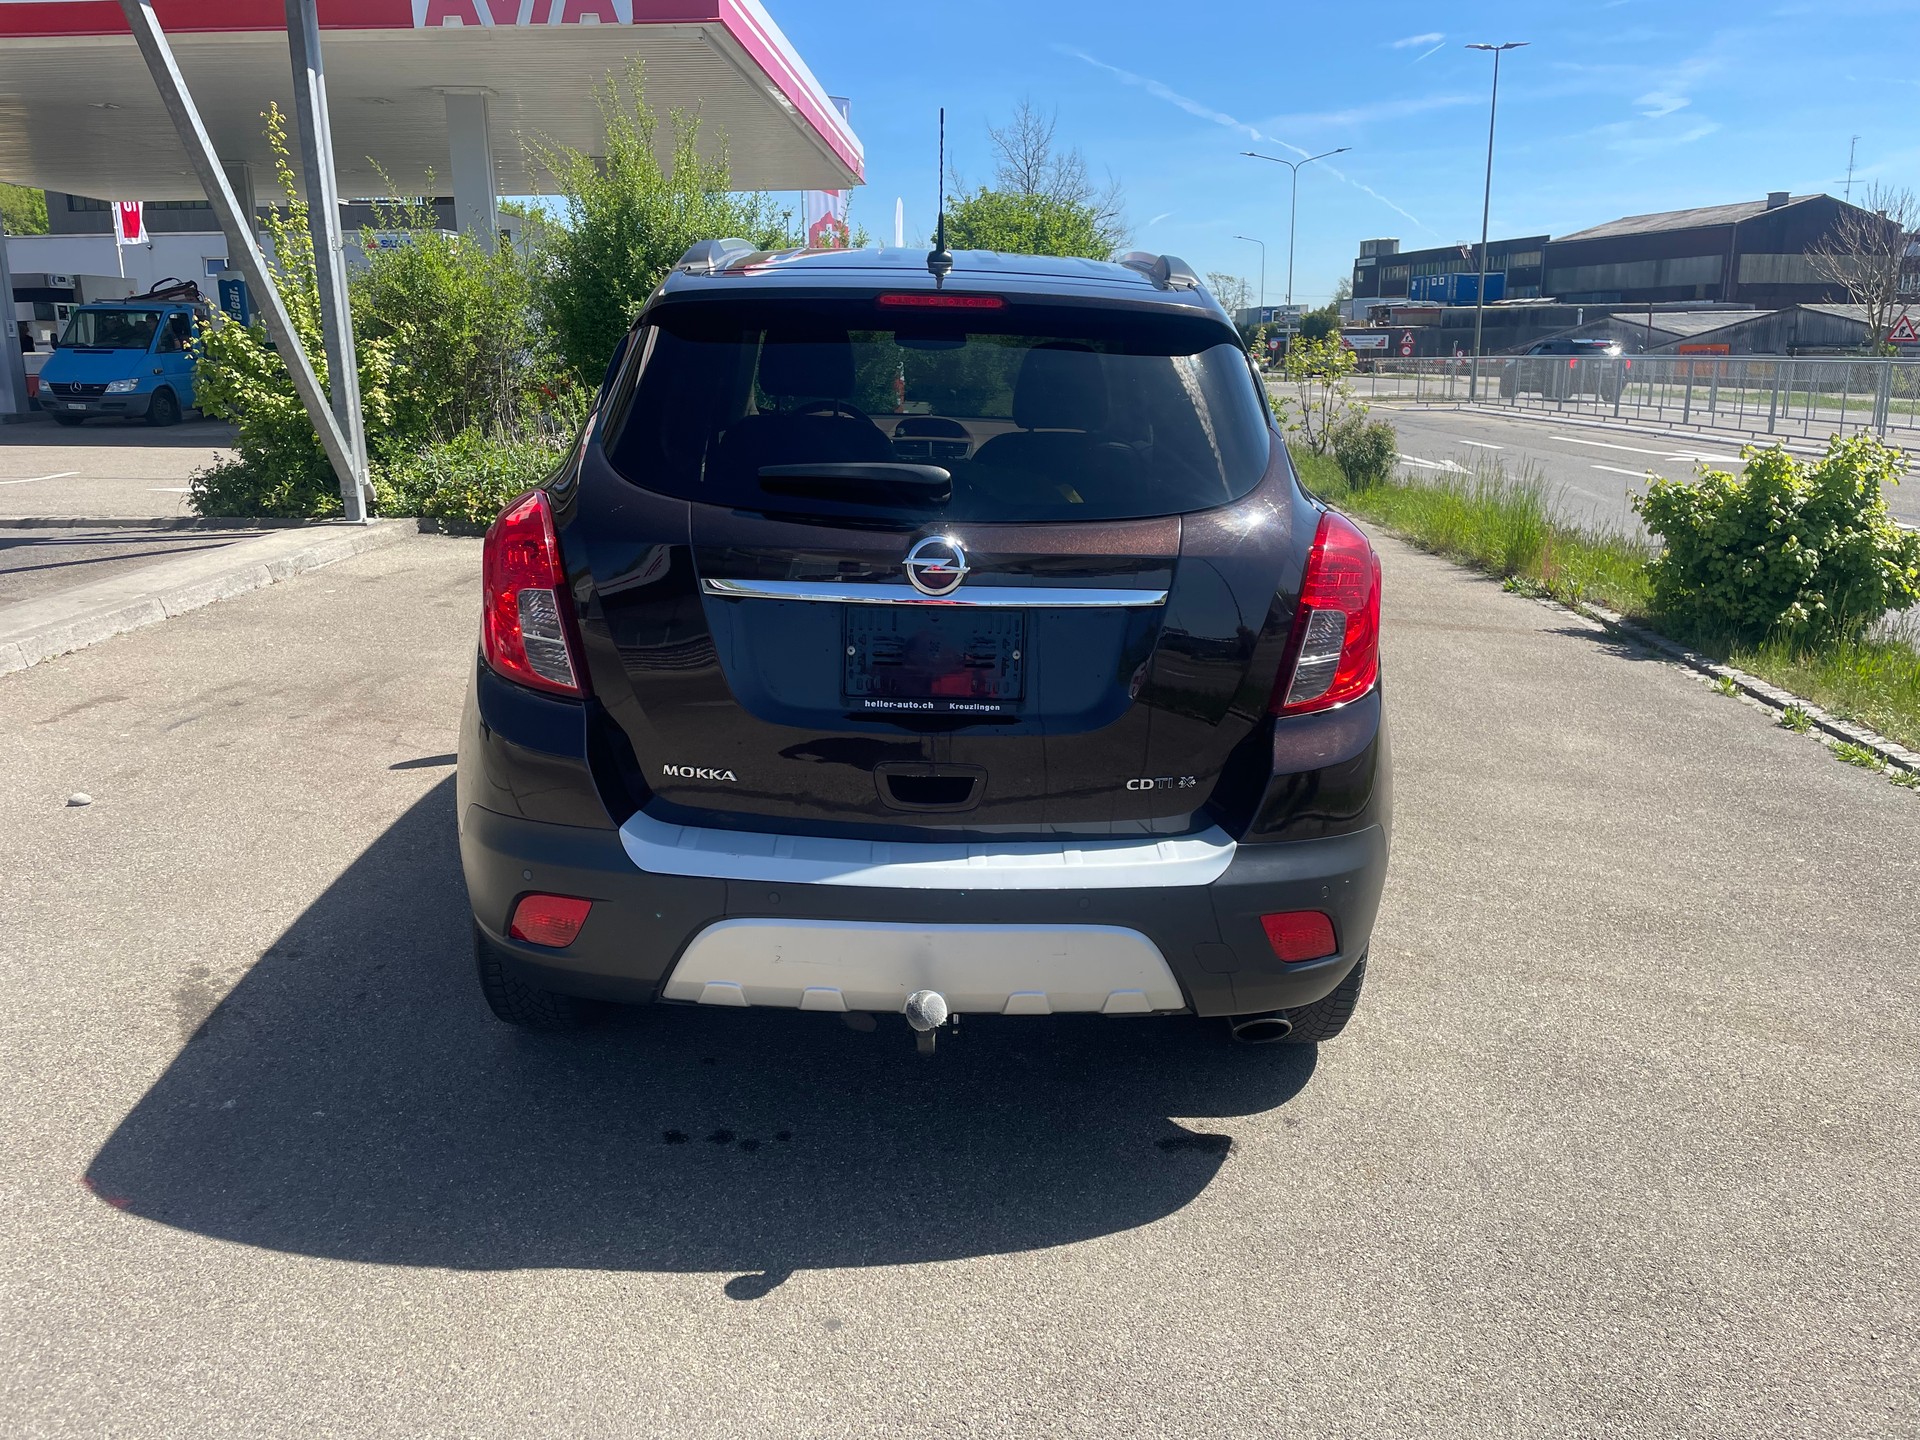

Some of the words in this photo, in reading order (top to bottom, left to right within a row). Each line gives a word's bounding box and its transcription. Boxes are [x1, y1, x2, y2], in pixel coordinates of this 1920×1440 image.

[864, 699, 934, 709] heller-auto.ch
[949, 702, 1000, 712] Kreuzlingen
[662, 764, 738, 782] MOKKA
[1126, 777, 1173, 791] CDTI
